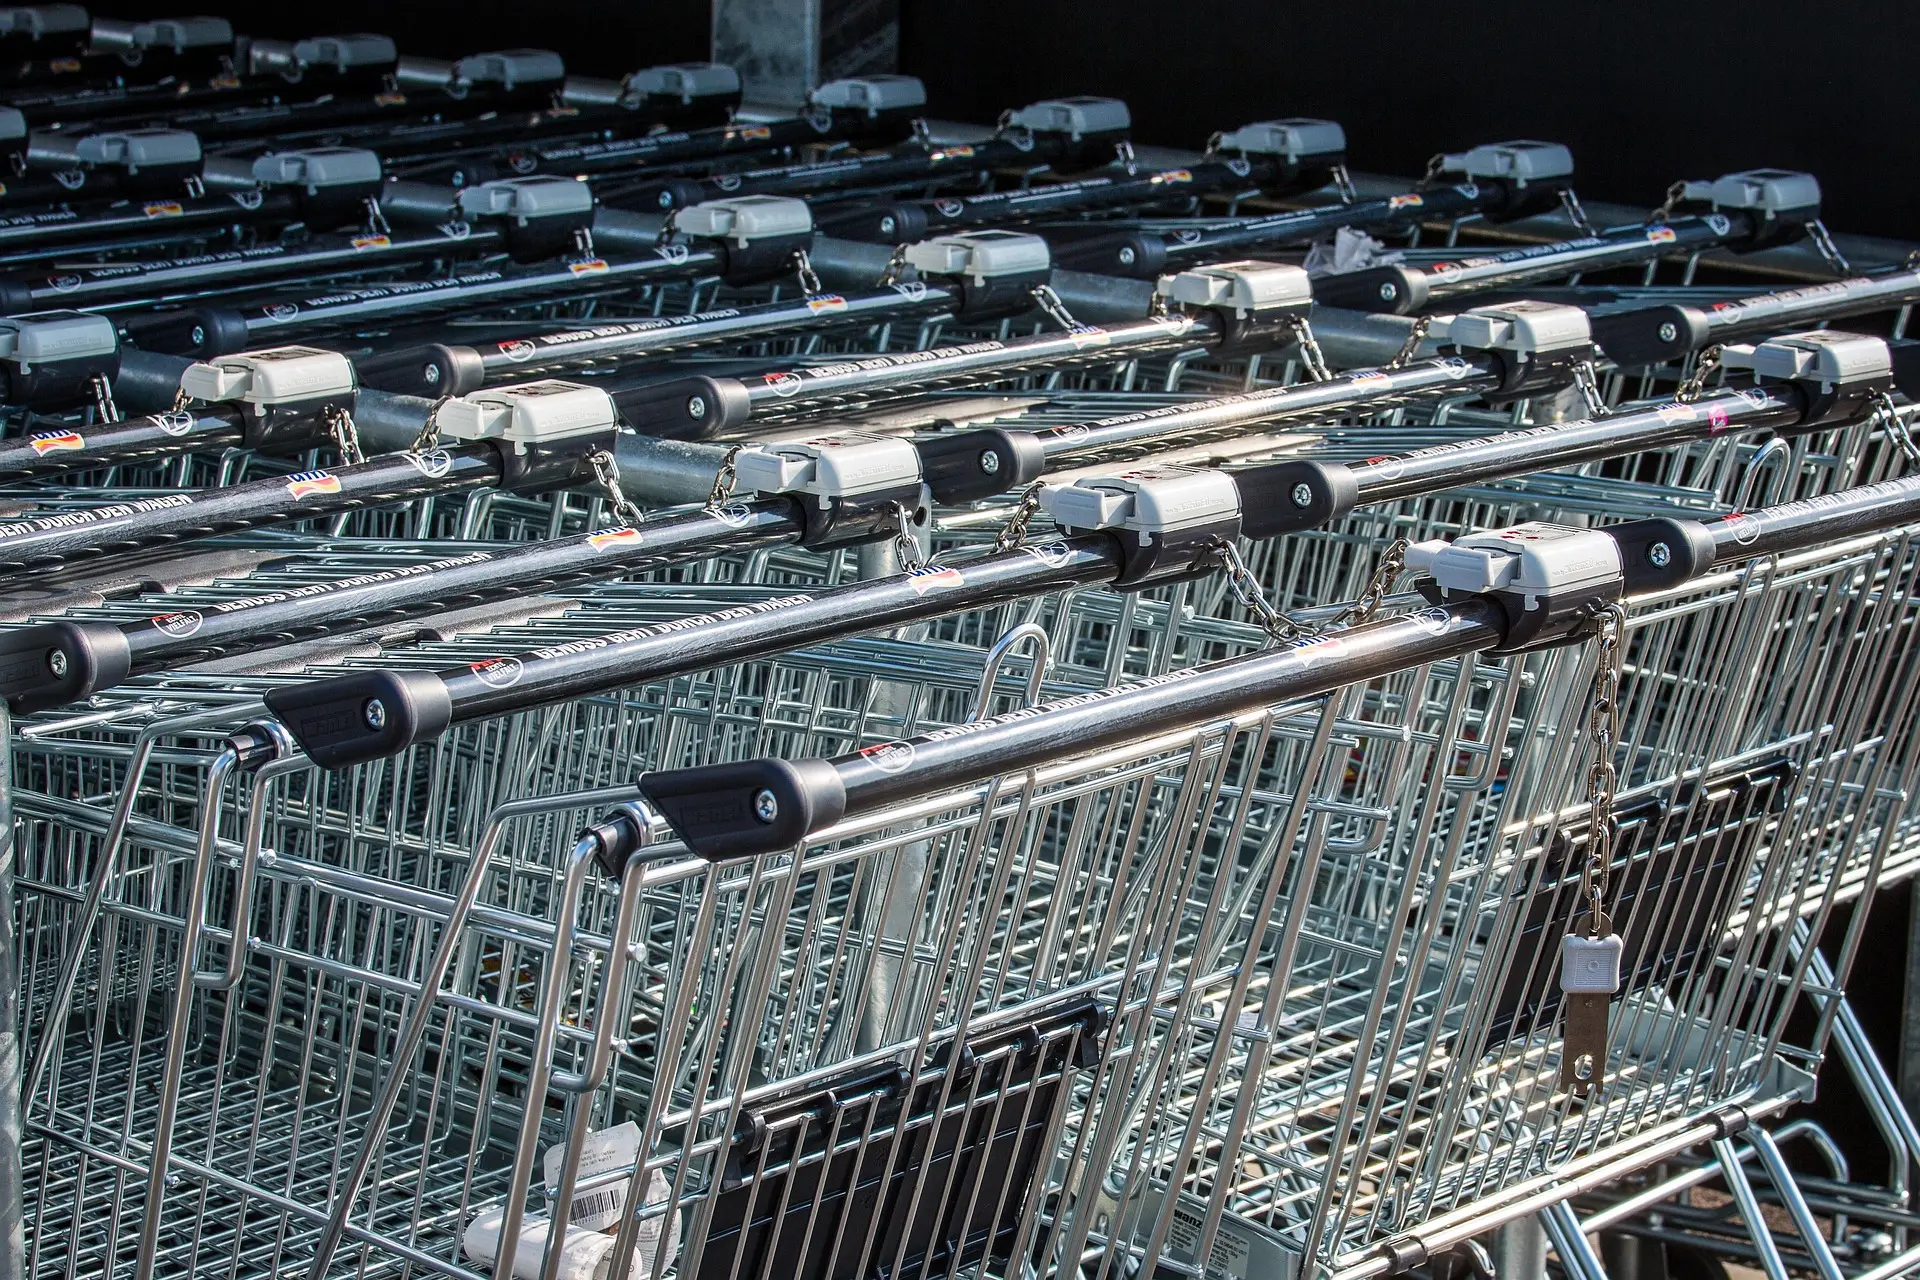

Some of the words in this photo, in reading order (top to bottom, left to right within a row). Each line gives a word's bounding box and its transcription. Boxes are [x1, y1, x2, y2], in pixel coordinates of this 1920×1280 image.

[36, 510, 97, 531] DURCH
[93, 504, 134, 519] DEN
[130, 493, 194, 513] WAGEN
[213, 589, 286, 613] GENUSS
[533, 637, 608, 660] GENUSS
[608, 627, 655, 644] GEHT
[752, 594, 816, 613] WAGEN
[1173, 1209, 1203, 1228] wanz
